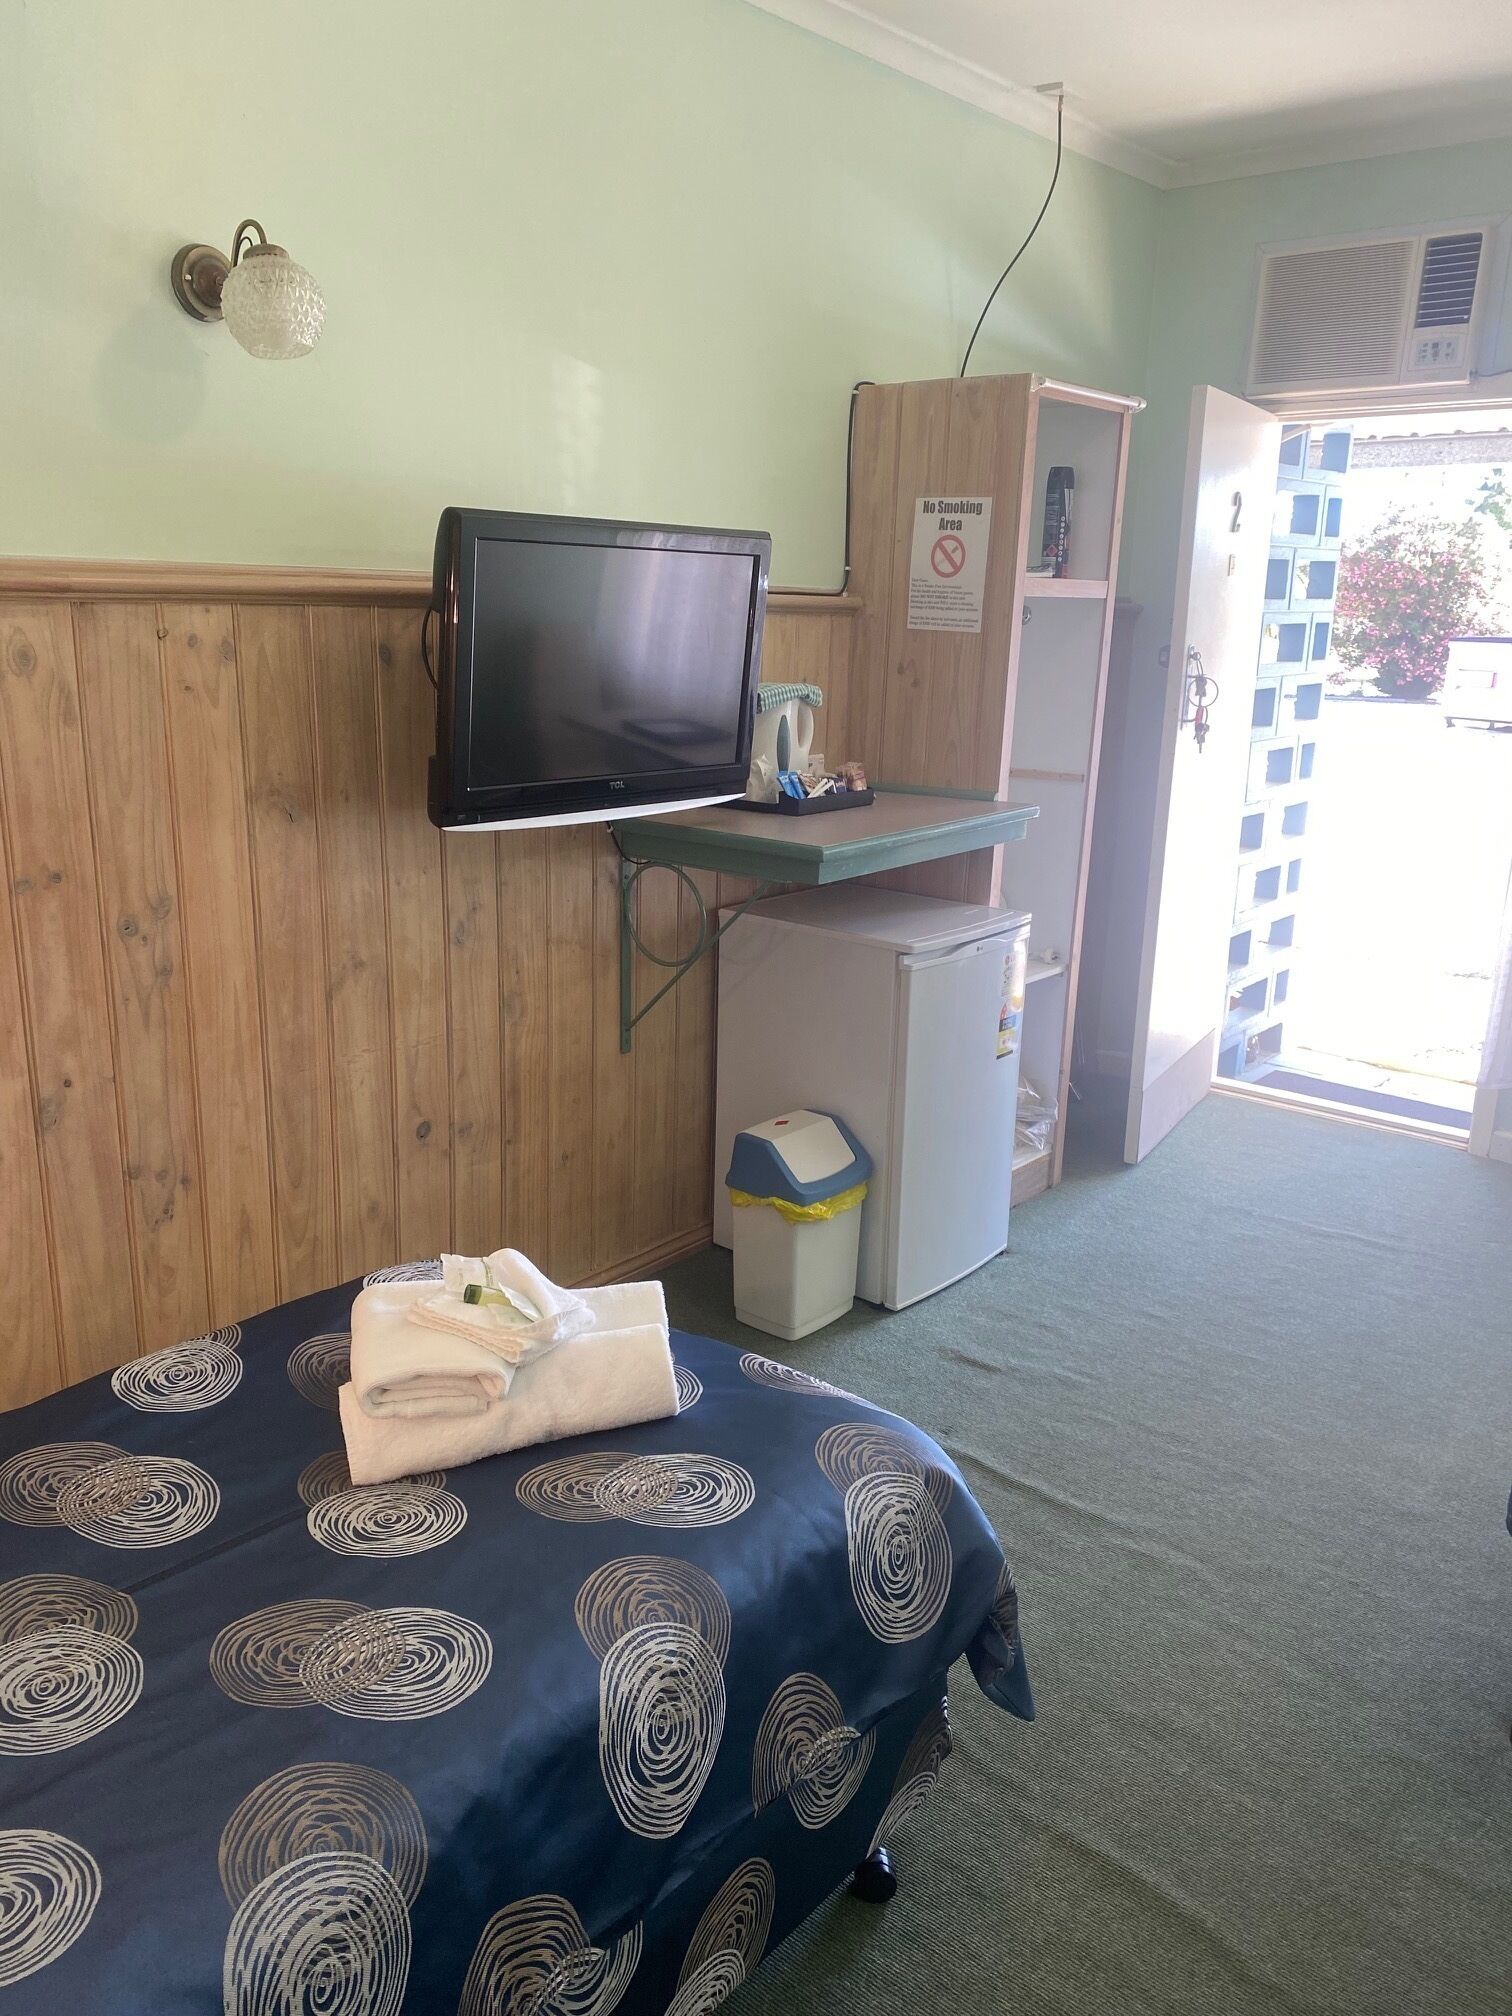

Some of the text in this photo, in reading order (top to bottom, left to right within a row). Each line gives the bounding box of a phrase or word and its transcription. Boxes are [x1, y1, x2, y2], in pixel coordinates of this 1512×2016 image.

[923, 500, 983, 516] No Smoking
[1229, 491, 1242, 532] 2
[939, 517, 963, 531] Area
[609, 781, 625, 790] TCL
